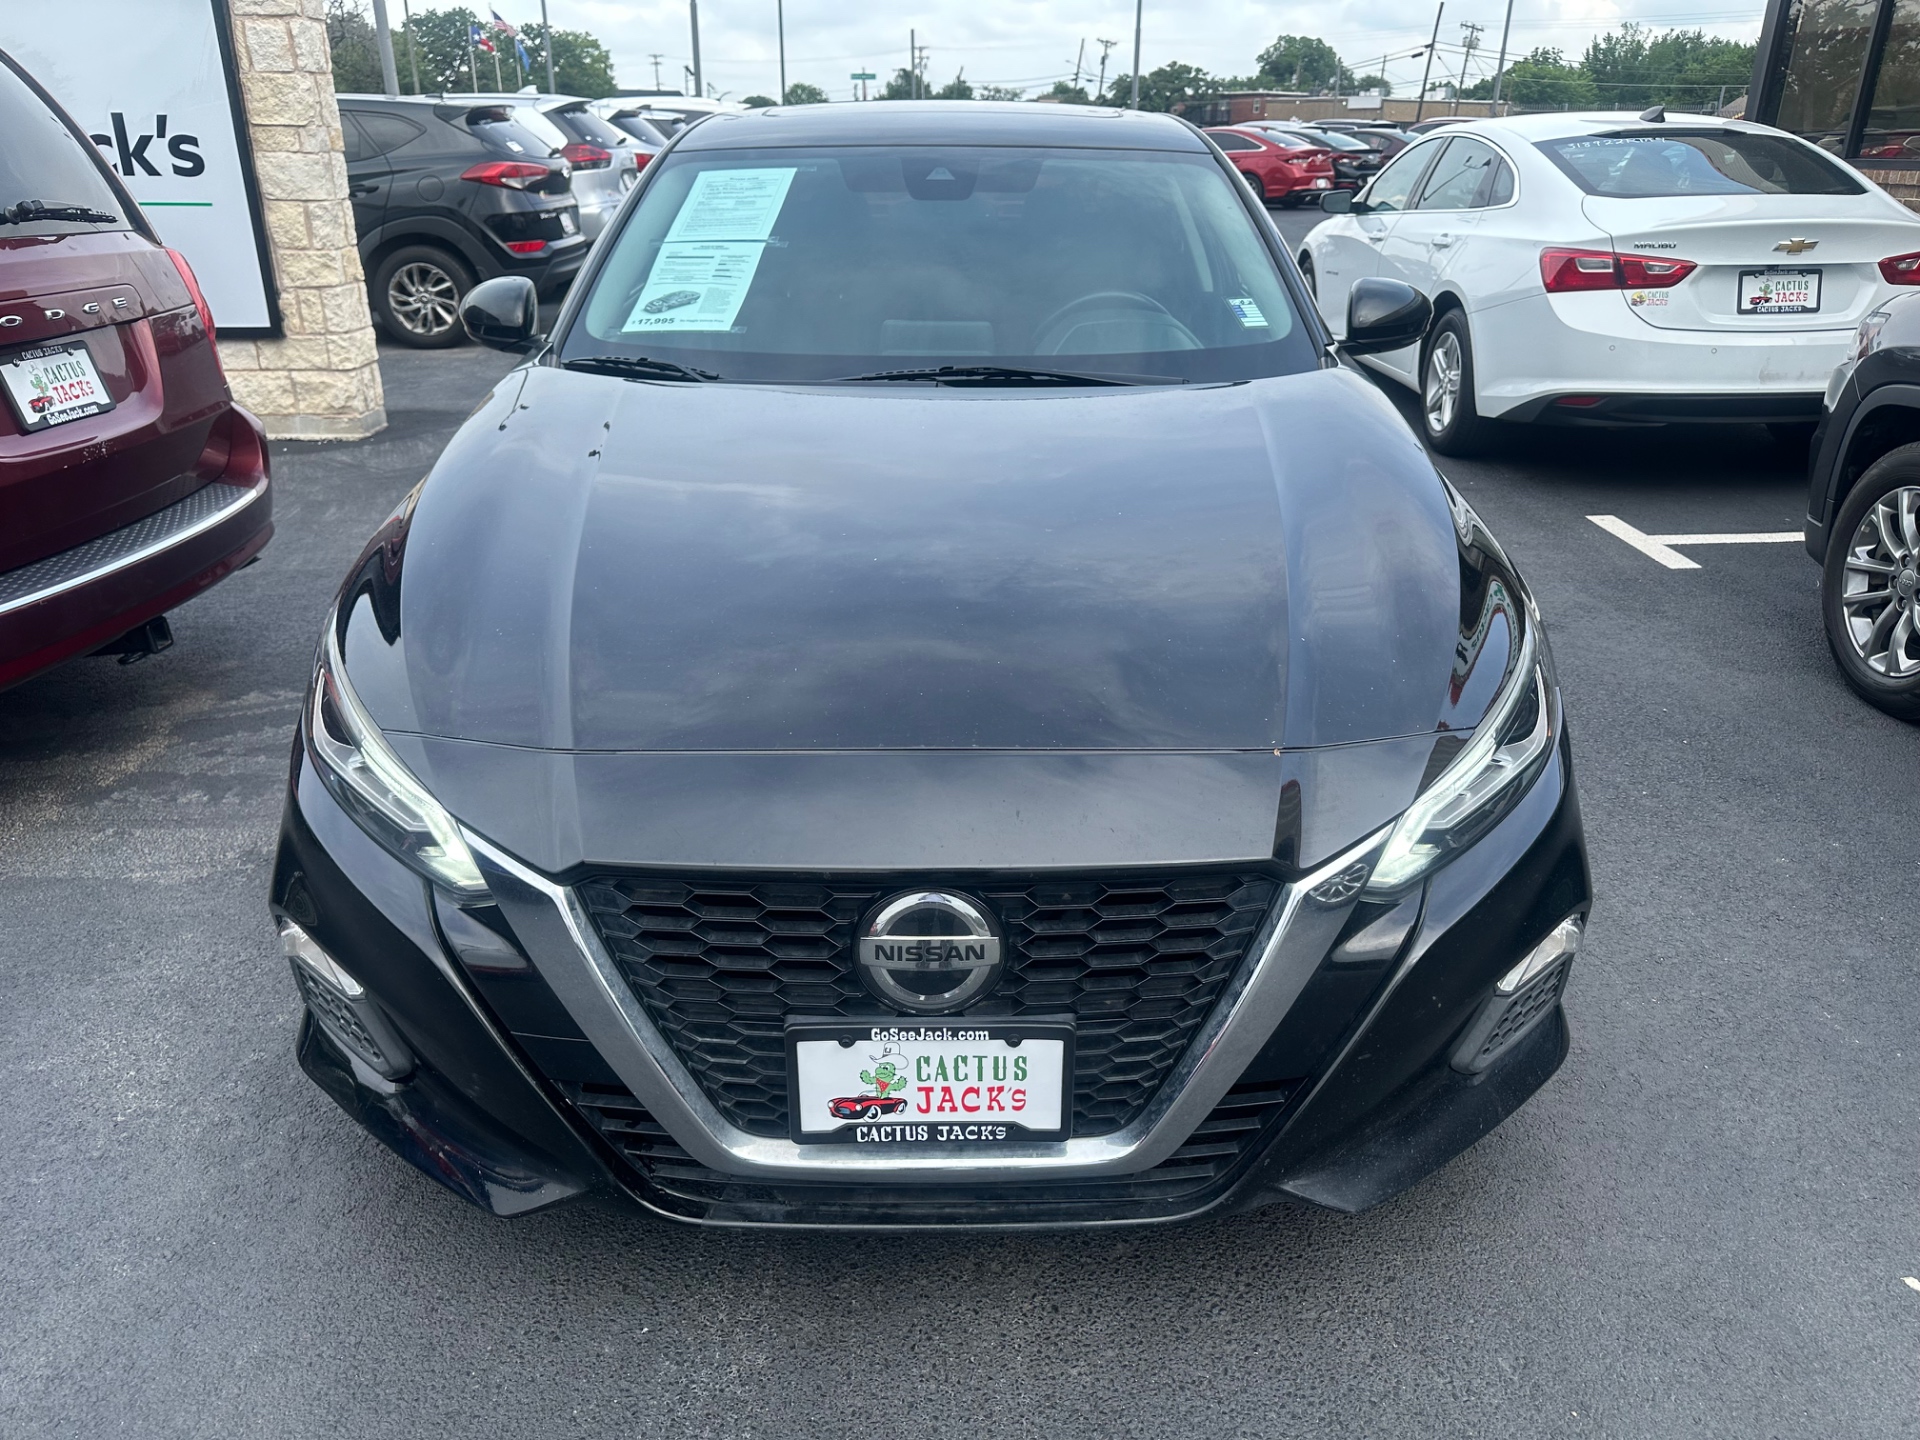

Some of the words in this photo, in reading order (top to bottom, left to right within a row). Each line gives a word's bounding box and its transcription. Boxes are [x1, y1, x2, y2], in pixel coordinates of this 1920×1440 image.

[1633, 241, 1677, 249] MALIBU
[1775, 280, 1809, 292] CACTUS
[21, 347, 44, 360] CACTUS
[43, 360, 87, 385] CACTUS
[46, 404, 100, 426] GoSeeJack.com
[874, 944, 985, 962] NISSAN
[870, 1027, 990, 1042] GoSeeJack.com
[915, 1055, 1028, 1082] CACTUS
[856, 1125, 929, 1143] CACTUS
